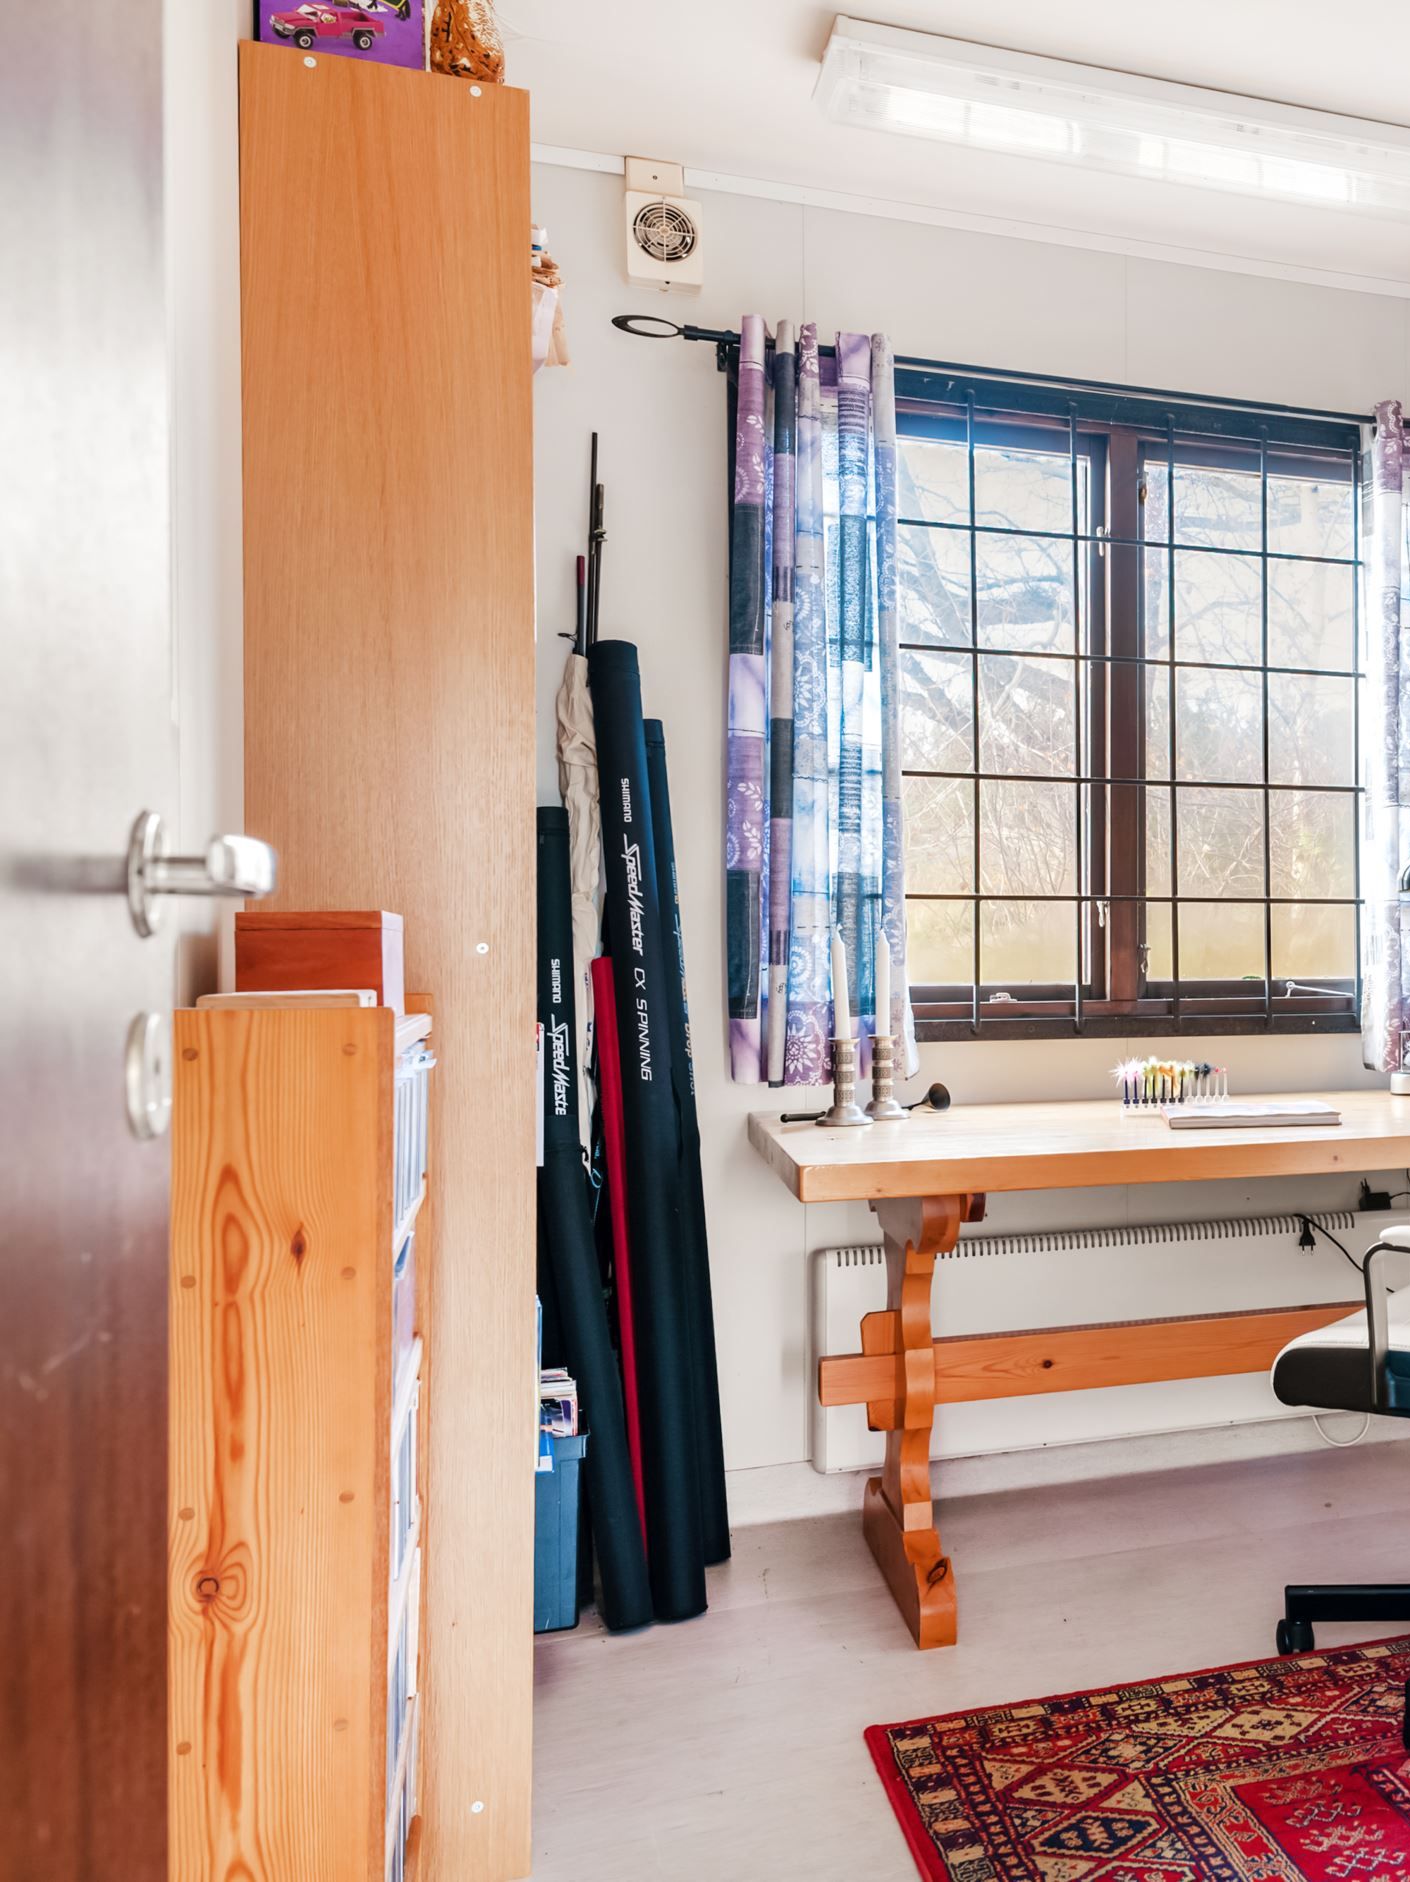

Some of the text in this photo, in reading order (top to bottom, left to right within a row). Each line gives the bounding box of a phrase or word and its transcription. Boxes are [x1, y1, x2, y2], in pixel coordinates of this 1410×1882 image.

[620, 777, 633, 823] SHIMANO
[620, 833, 652, 1081] SpeedMaster CX SPINNING
[550, 958, 562, 1004] SHIMANO
